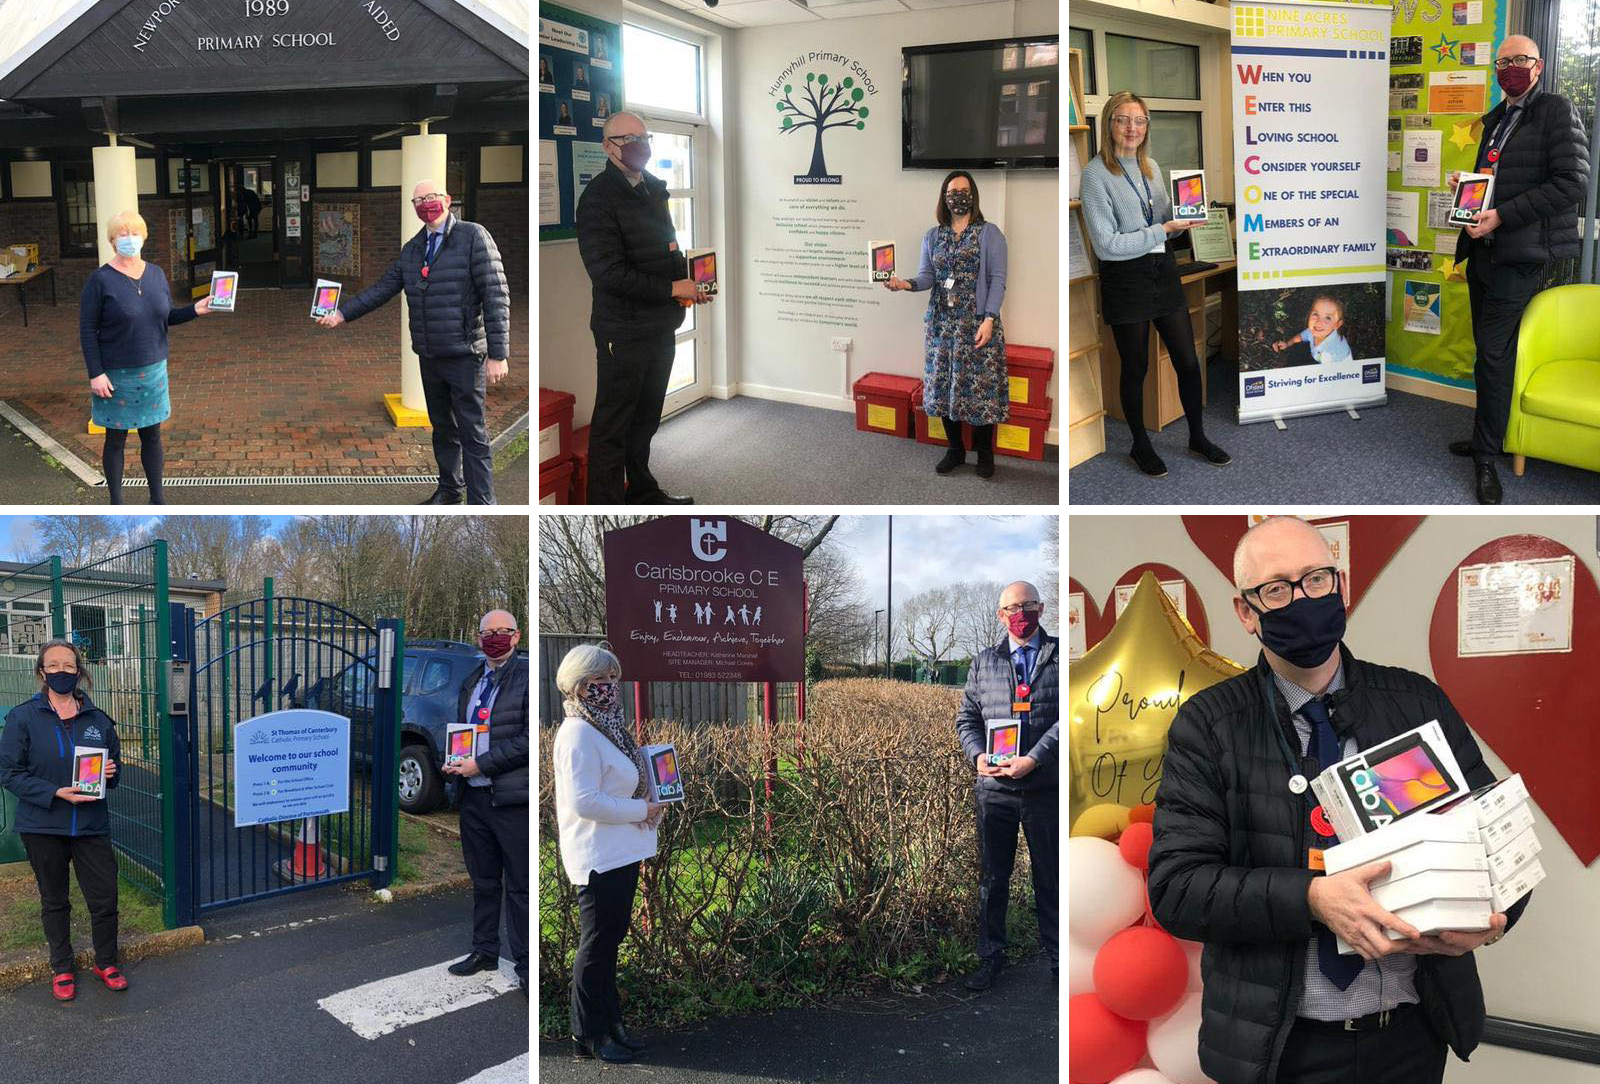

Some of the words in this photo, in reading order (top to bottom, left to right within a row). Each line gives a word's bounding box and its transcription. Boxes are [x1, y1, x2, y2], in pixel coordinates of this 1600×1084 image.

[245, 0, 290, 17] 1989
[1267, 8, 1299, 23] NINE
[1303, 11, 1348, 24] ACRES
[362, 0, 401, 42] AIDED
[198, 35, 263, 51] PRIMARY
[272, 32, 337, 48] SCHOOL
[1267, 25, 1328, 39] PRIMARY
[1333, 28, 1385, 43] SCHOOL
[768, 55, 806, 97] Hunnyhill
[808, 50, 850, 66] Primary
[850, 60, 879, 96] School
[1236, 64, 1284, 85] WHEN
[1288, 72, 1312, 83] YOU
[1244, 95, 1285, 116] ENTER
[1289, 102, 1312, 113] THIS
[1246, 125, 1294, 146] LOVING
[1297, 132, 1340, 143] SCHOOL
[1244, 155, 1307, 175] CONSIDER
[1310, 161, 1361, 172] YOURSELF
[1243, 185, 1278, 205] ONE
[1281, 191, 1295, 200] OF
[1298, 190, 1317, 200] THE
[1320, 189, 1359, 200] SPECIAL
[1173, 205, 1197, 216] Tab
[1243, 213, 1305, 233] MEMBERS
[1308, 217, 1322, 227] OF
[1324, 217, 1340, 227] AN
[1248, 242, 1340, 261] EXTRAORDINARY
[1343, 242, 1377, 253] FAMILY
[1268, 378, 1303, 389] Striving
[1304, 375, 1316, 385] for
[1318, 371, 1360, 383] Excellence
[634, 561, 745, 584] Carisbrooke
[749, 569, 763, 586] C
[768, 570, 779, 587] E
[659, 583, 710, 597] PRIMARY
[712, 586, 759, 599] SCHOOL
[630, 629, 659, 644] Enjoy,
[663, 629, 709, 644] Endeavour,
[750, 632, 785, 648] Together
[1086, 669, 1186, 745] Proud
[271, 729, 277, 737] St
[278, 728, 300, 737] Thomas
[300, 727, 308, 735] of
[307, 726, 338, 735] Canterbury
[271, 736, 292, 744] Catholic
[293, 735, 313, 743] Primary
[248, 753, 287, 764] Welcome
[288, 752, 297, 760] to
[298, 751, 313, 760] our
[313, 748, 339, 759] school
[271, 762, 318, 774] community
[1091, 752, 1128, 804] Of
[1345, 753, 1380, 811] Tab
[656, 784, 675, 796] Tab
